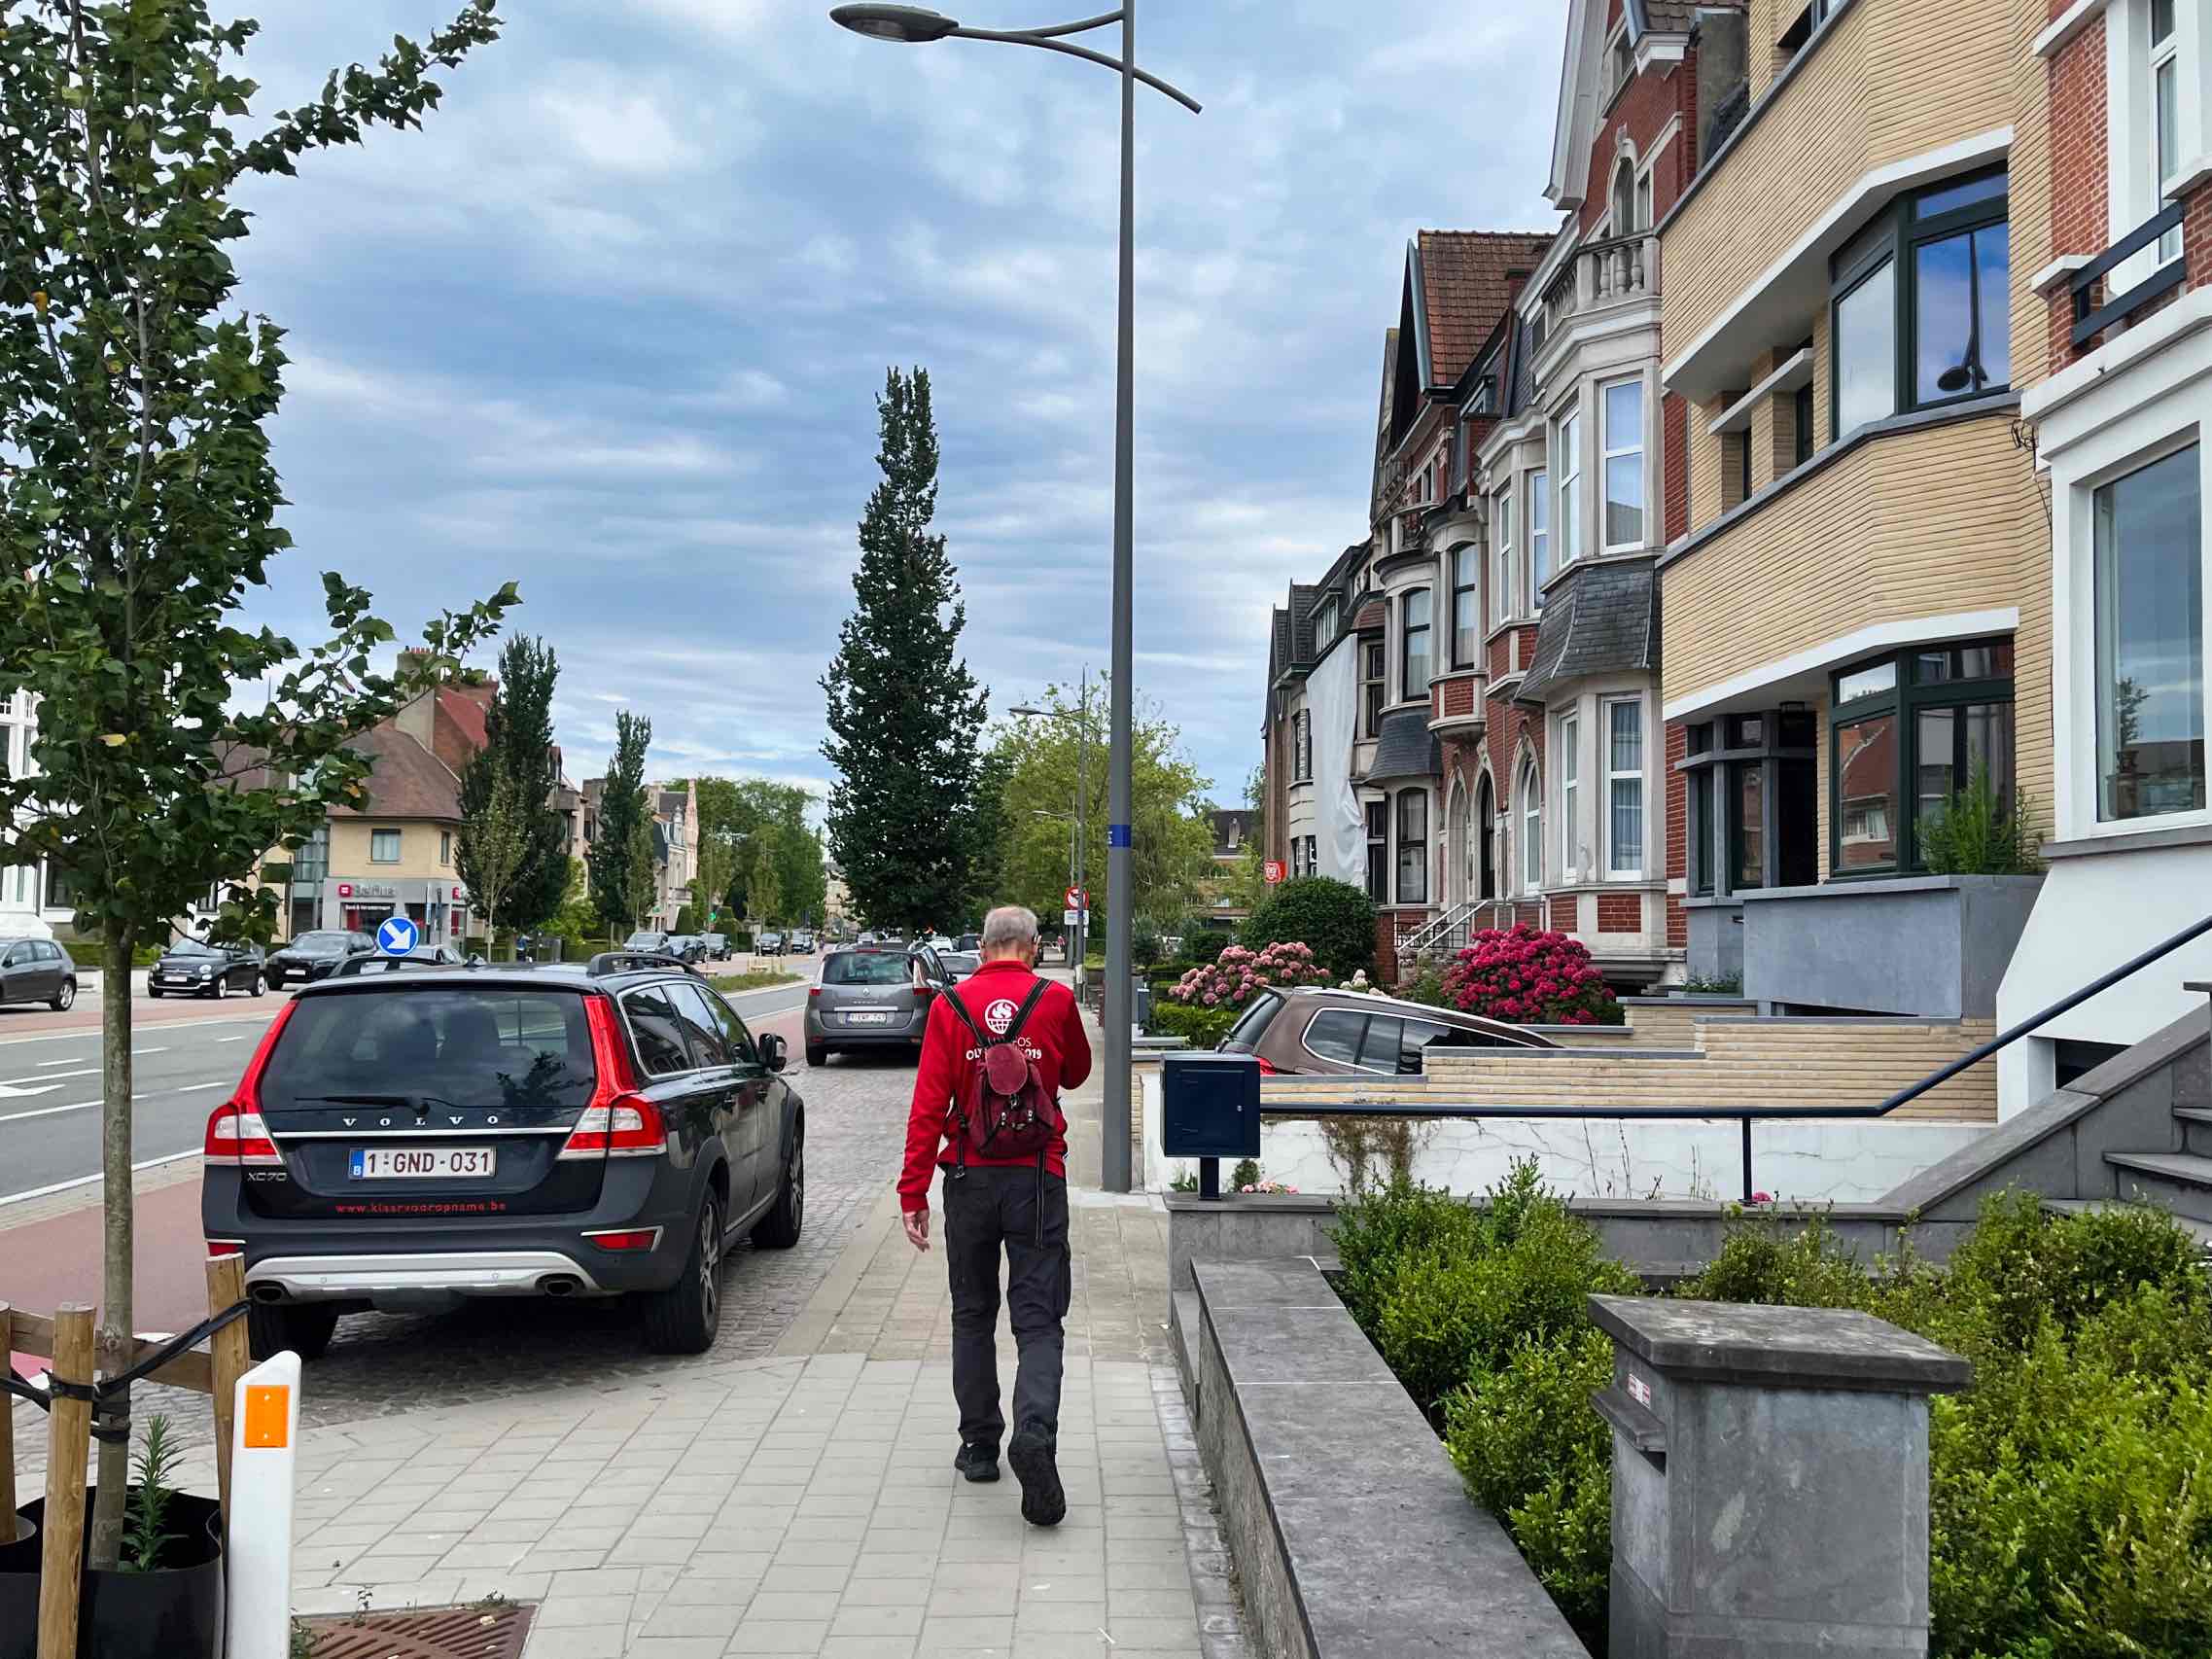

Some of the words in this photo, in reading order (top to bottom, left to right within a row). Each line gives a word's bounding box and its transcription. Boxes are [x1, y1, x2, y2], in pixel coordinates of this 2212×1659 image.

[343, 1115, 498, 1126] VOLVO
[368, 1152, 490, 1174] 1-GND-031
[247, 1172, 288, 1182] XC70
